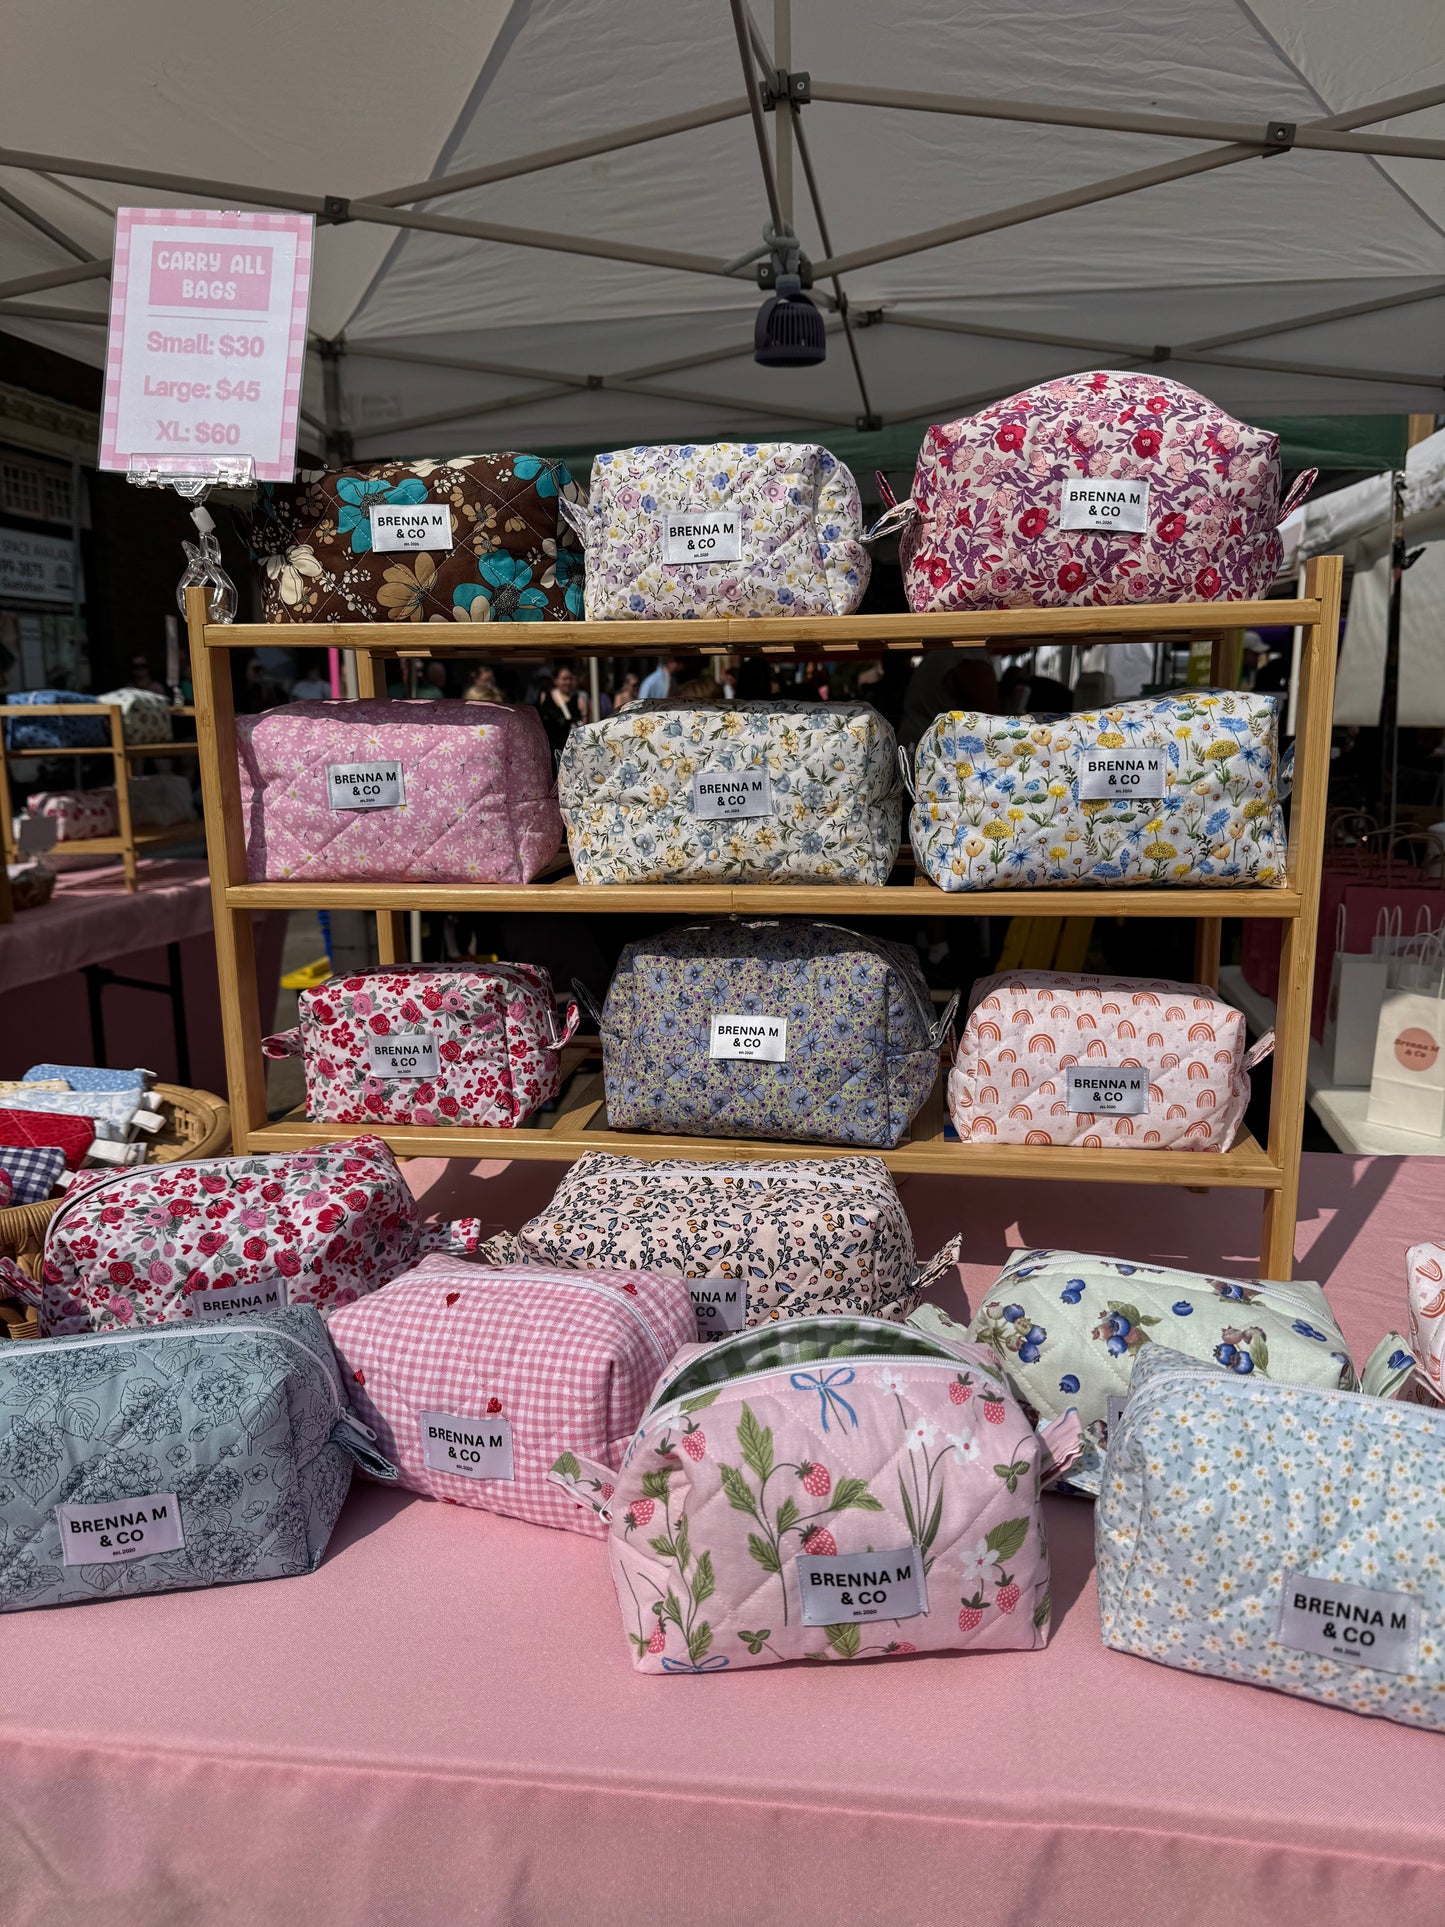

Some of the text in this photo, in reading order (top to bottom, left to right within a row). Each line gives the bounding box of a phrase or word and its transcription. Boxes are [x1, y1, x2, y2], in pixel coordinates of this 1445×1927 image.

[158, 250, 266, 275] CARRY ALL
[182, 279, 236, 300] BAGS
[146, 331, 265, 358] Small: $30
[144, 375, 261, 403] Large: $45
[155, 419, 241, 446] XL: $60
[1070, 491, 1141, 505] BRENNA M
[1089, 505, 1121, 517] & CO
[377, 516, 443, 527] BRENNA M
[396, 528, 426, 539] & CO
[669, 523, 734, 537] BRENNA M
[687, 538, 716, 550] & CO
[1088, 760, 1159, 772] BRENNA M
[334, 771, 397, 784] BRENNA M
[1108, 774, 1140, 786] & CO
[352, 785, 381, 796] & CO
[699, 781, 763, 795] BRENNA M
[717, 795, 746, 806] & CO
[718, 1025, 779, 1037] BRENNA M
[374, 1044, 433, 1055] BRENNA M
[733, 1038, 761, 1048] & CO
[391, 1057, 417, 1067] & CO
[1074, 1078, 1141, 1090] BRENNA M
[1092, 1092, 1123, 1102] & CO
[203, 1291, 277, 1311] BRENNA M
[690, 1291, 737, 1303] NNA M
[695, 1306, 717, 1318] CO
[428, 1427, 503, 1448] BRENNA M
[448, 1447, 481, 1463] & CO
[70, 1506, 168, 1534] BRENNA M
[99, 1529, 145, 1548] & CO
[810, 1565, 912, 1588] BRENNA M
[840, 1590, 888, 1606] & CO
[1293, 1593, 1408, 1631] BRENNA M
[1322, 1622, 1376, 1648] & CO
